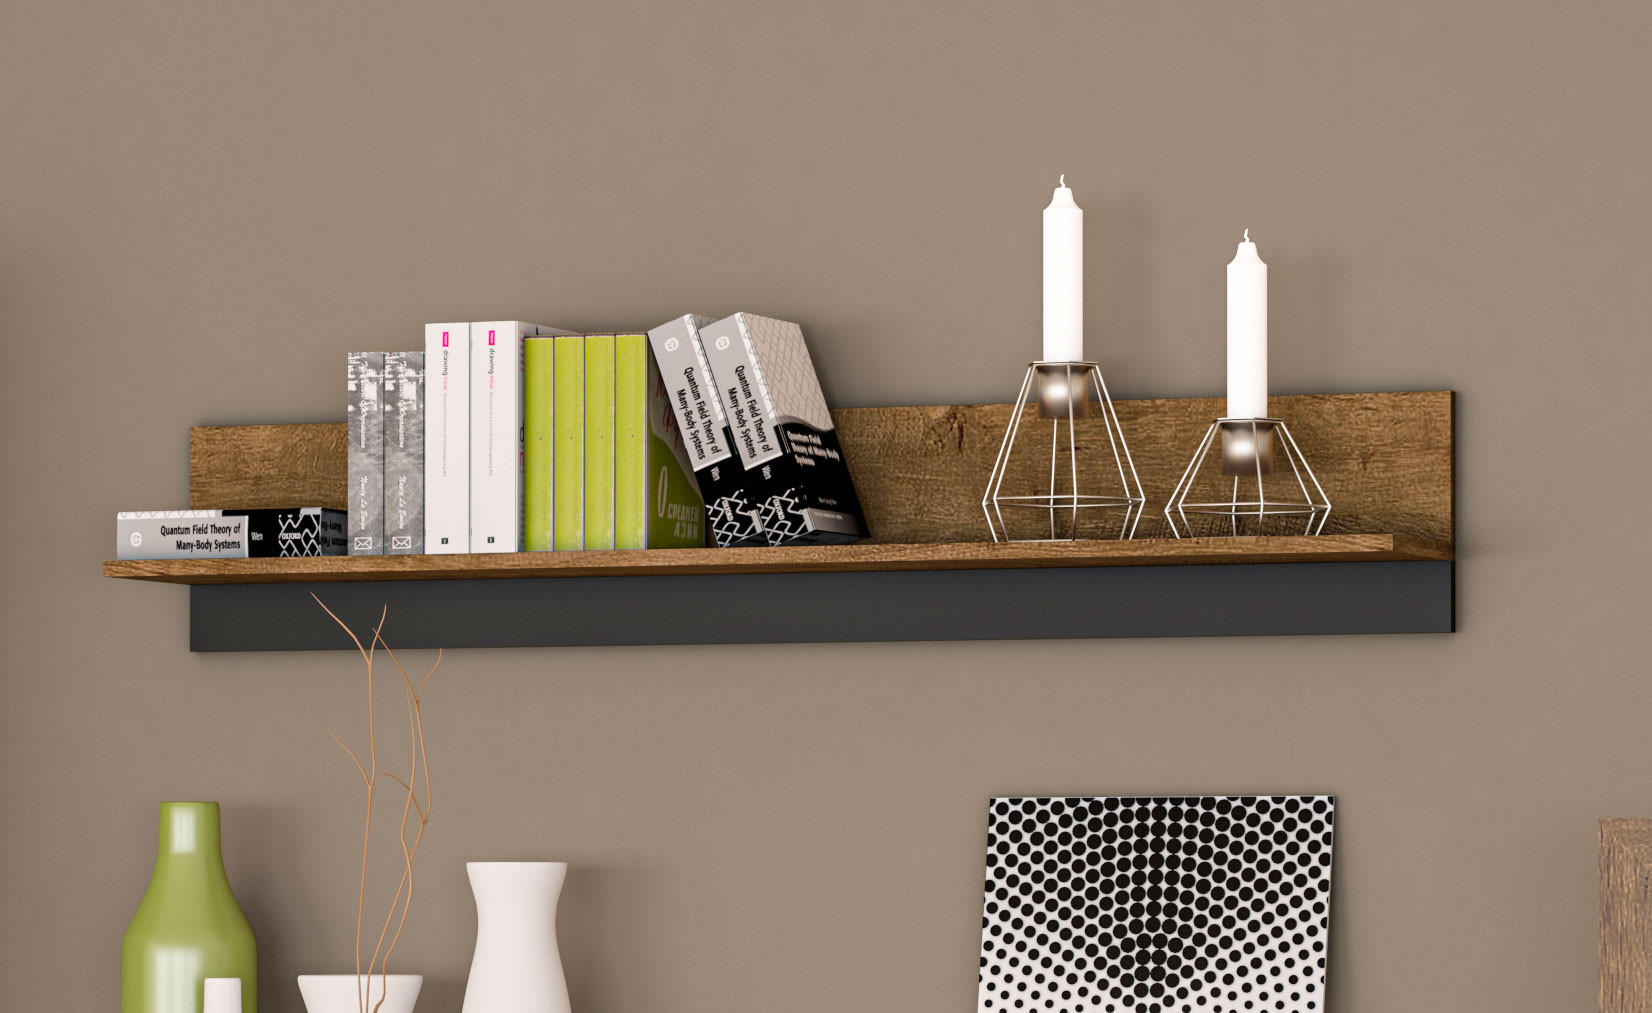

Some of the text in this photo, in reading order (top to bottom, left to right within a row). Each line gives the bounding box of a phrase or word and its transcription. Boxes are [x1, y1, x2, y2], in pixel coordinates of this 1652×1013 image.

[684, 367, 722, 454] Quantum Field Theory of
[735, 365, 773, 452] Quantum Field Theory of
[677, 388, 706, 460] Many-Body Systems
[728, 387, 757, 459] Many-Body Systems
[711, 466, 720, 481] Wen
[762, 465, 771, 480] Wen
[722, 500, 733, 521] OXFORD
[773, 498, 785, 520] OXFORD
[160, 523, 241, 536] Quantum Field Theory of
[251, 532, 263, 540] Wen
[176, 539, 241, 551] Many-Body Systems
